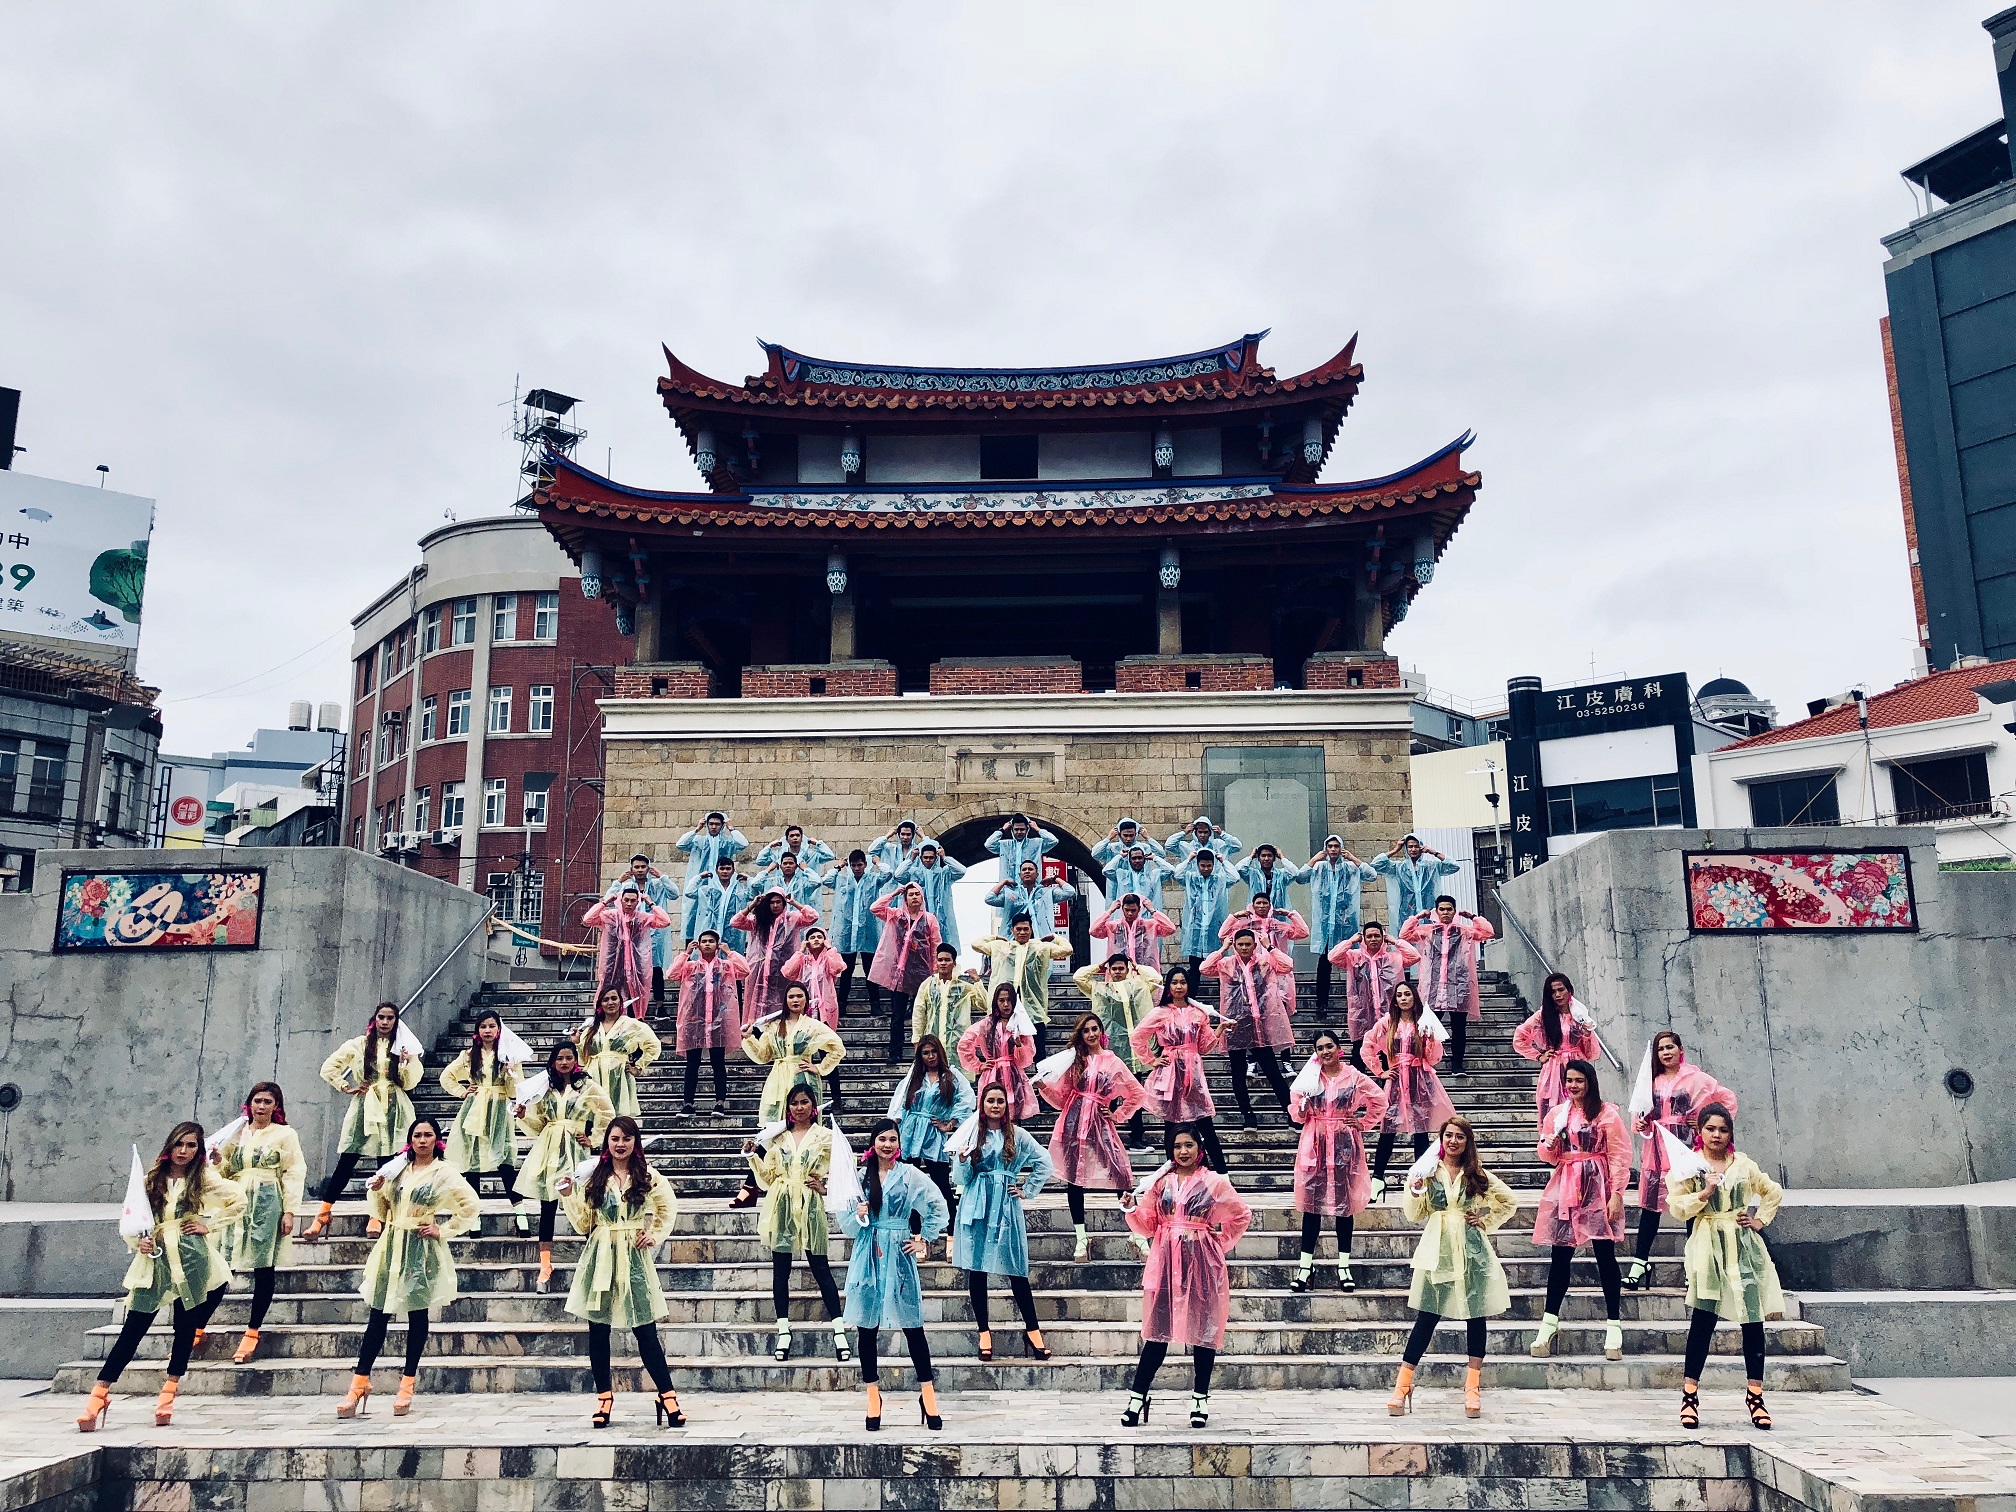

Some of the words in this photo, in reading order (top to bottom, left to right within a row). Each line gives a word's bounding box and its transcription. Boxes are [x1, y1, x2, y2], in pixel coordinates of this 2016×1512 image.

[0, 531, 30, 550] 中
[0, 562, 36, 592] 9
[1557, 681, 1664, 711] 江皮膚科
[1576, 702, 1646, 718] 03-5250236
